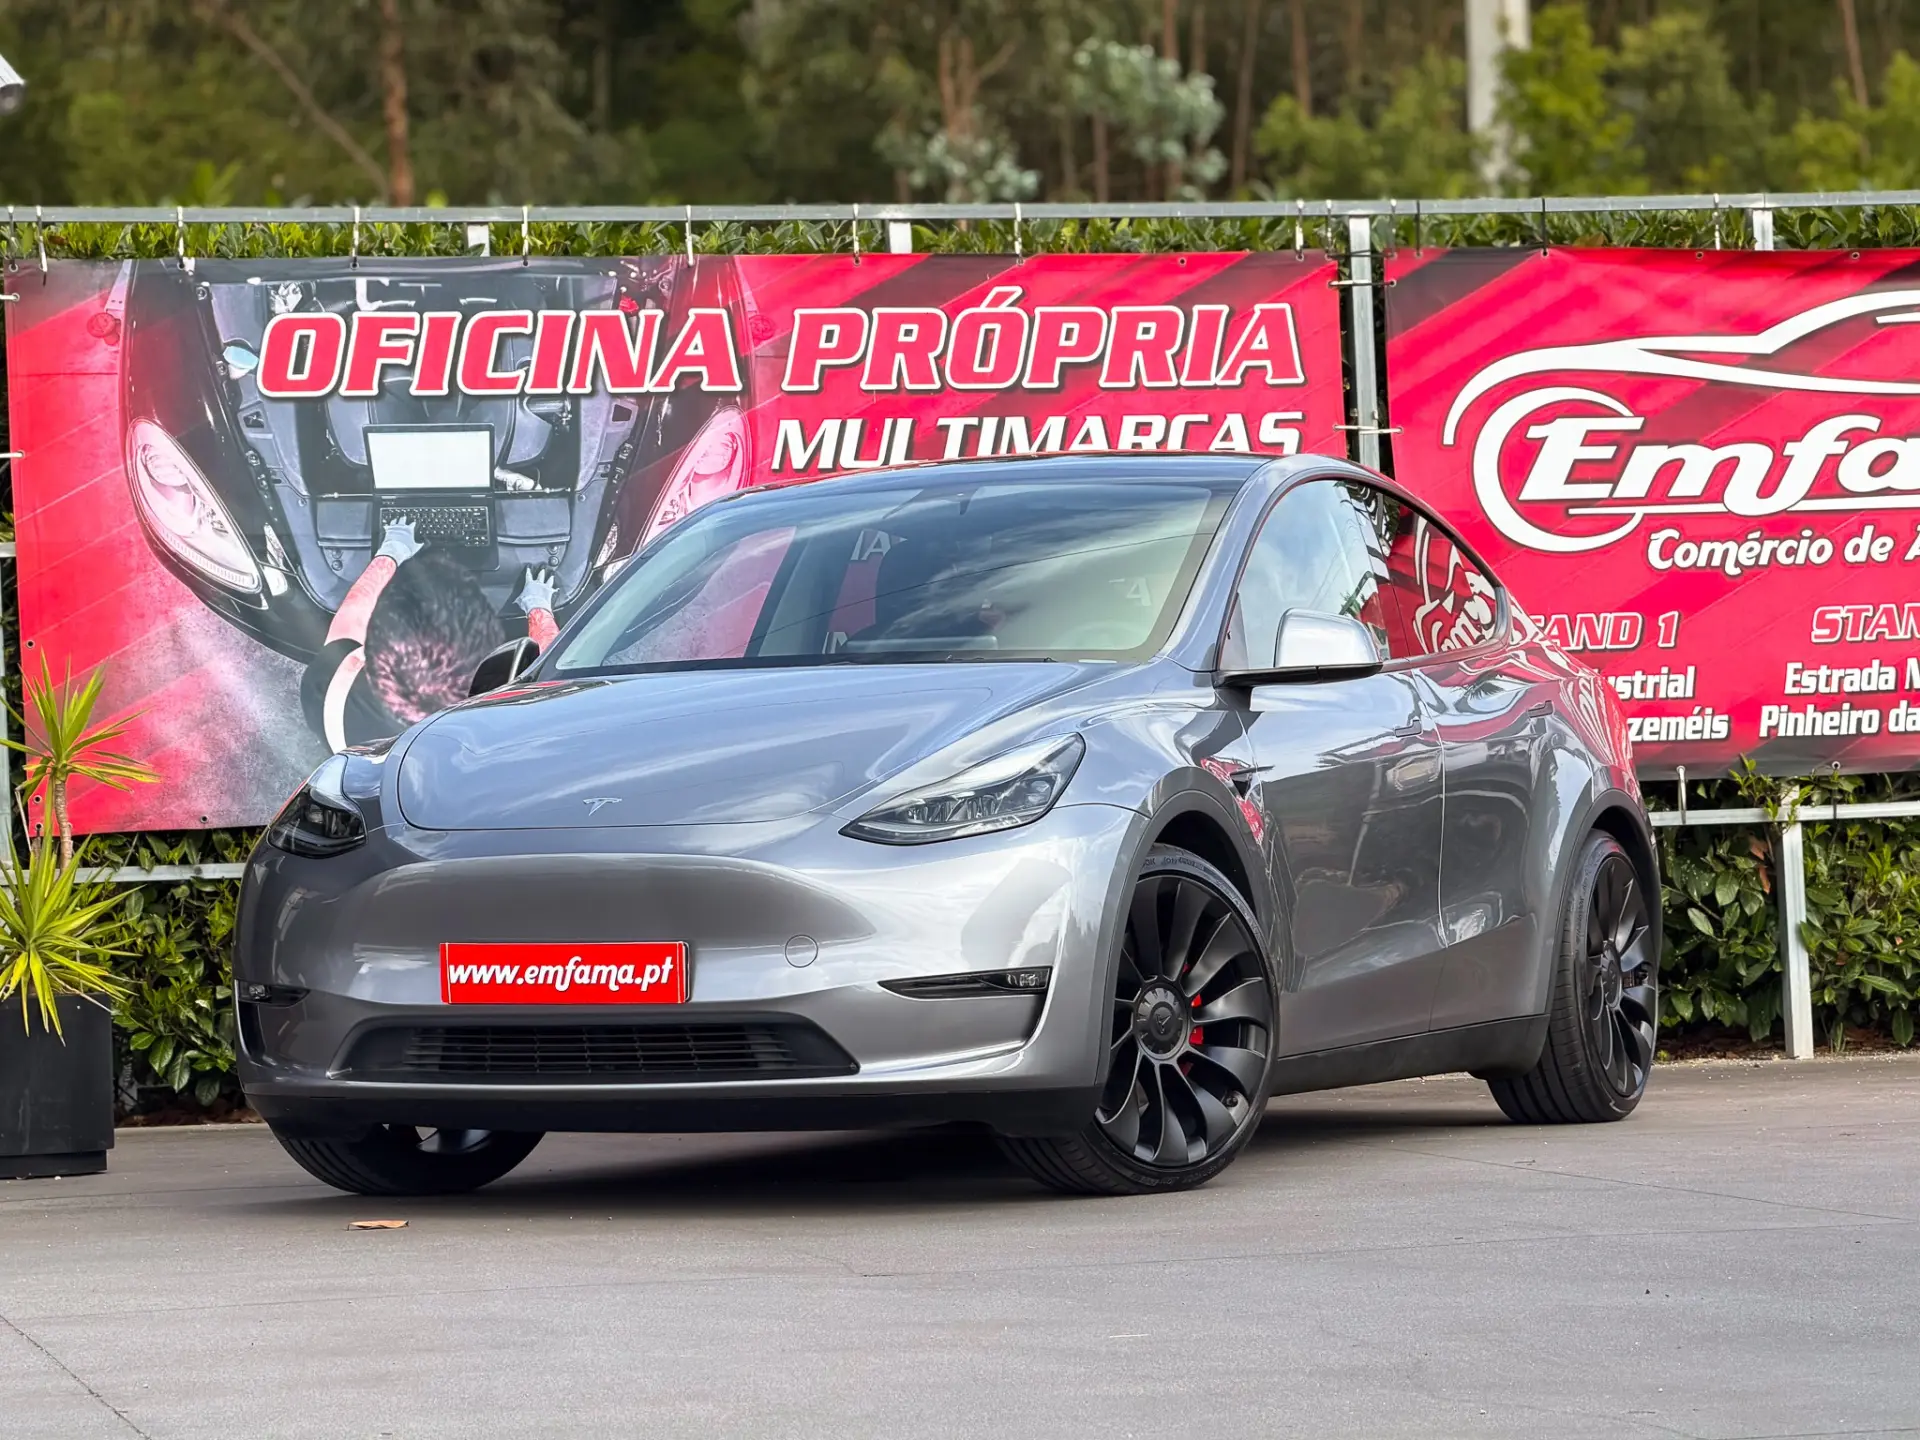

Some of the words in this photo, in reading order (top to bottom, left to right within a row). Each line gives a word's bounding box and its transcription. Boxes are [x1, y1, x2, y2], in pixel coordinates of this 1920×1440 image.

[256, 308, 743, 397] OFICINA
[781, 285, 1307, 391] PRÓPRIA
[771, 411, 1304, 470] MULTIMARCAS
[1647, 528, 1834, 576] Comércio
[1843, 524, 1895, 563] de
[1529, 611, 1643, 651] AND
[1658, 610, 1679, 648] 1
[1605, 666, 1696, 700] strial
[1784, 659, 1897, 694] Estrada
[1759, 702, 1881, 737] Pinheiro
[449, 956, 674, 992] www.emfama.pt
